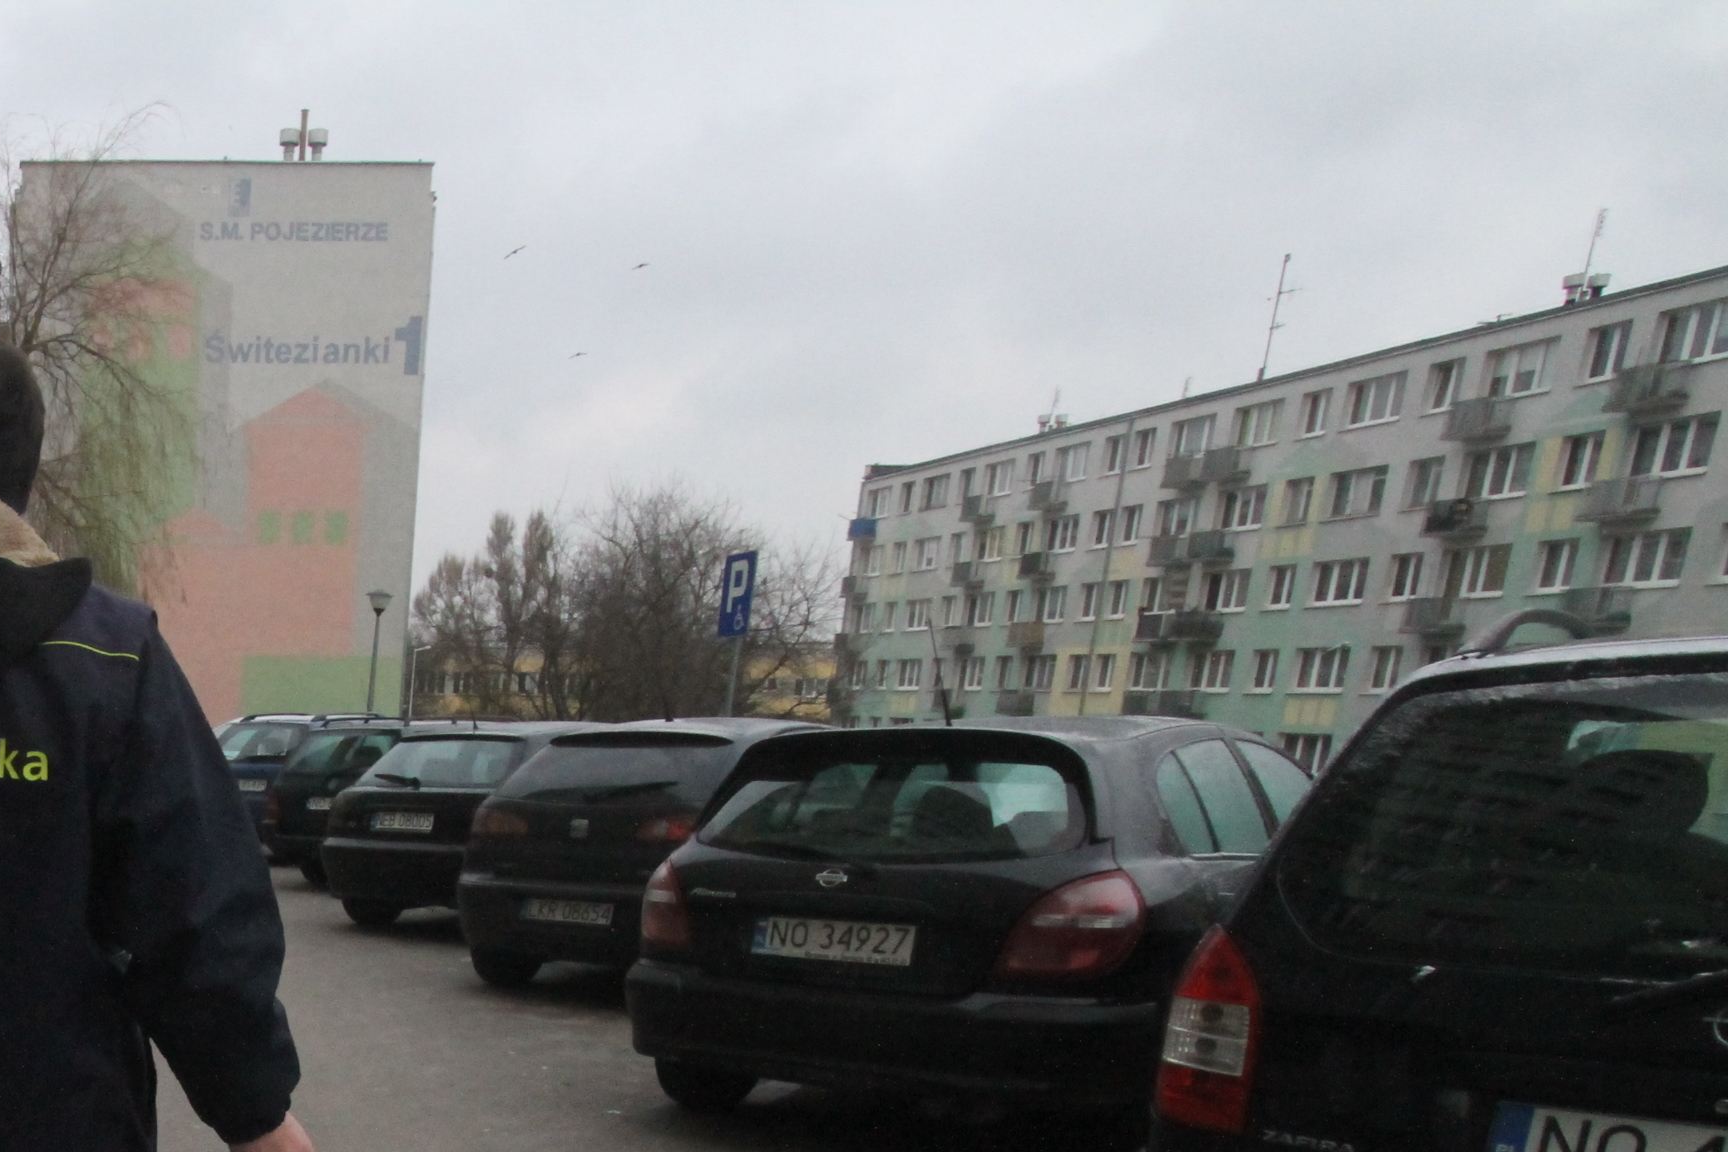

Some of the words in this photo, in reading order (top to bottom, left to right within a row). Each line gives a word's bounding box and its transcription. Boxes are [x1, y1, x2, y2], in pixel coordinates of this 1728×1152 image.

[199, 221, 243, 241] S.M.
[249, 221, 389, 242] POJEZIERZE
[204, 328, 390, 365] Świtezianki
[394, 315, 423, 376] 1
[725, 559, 749, 613] P
[769, 920, 809, 948] NO
[819, 924, 911, 955] 34927
